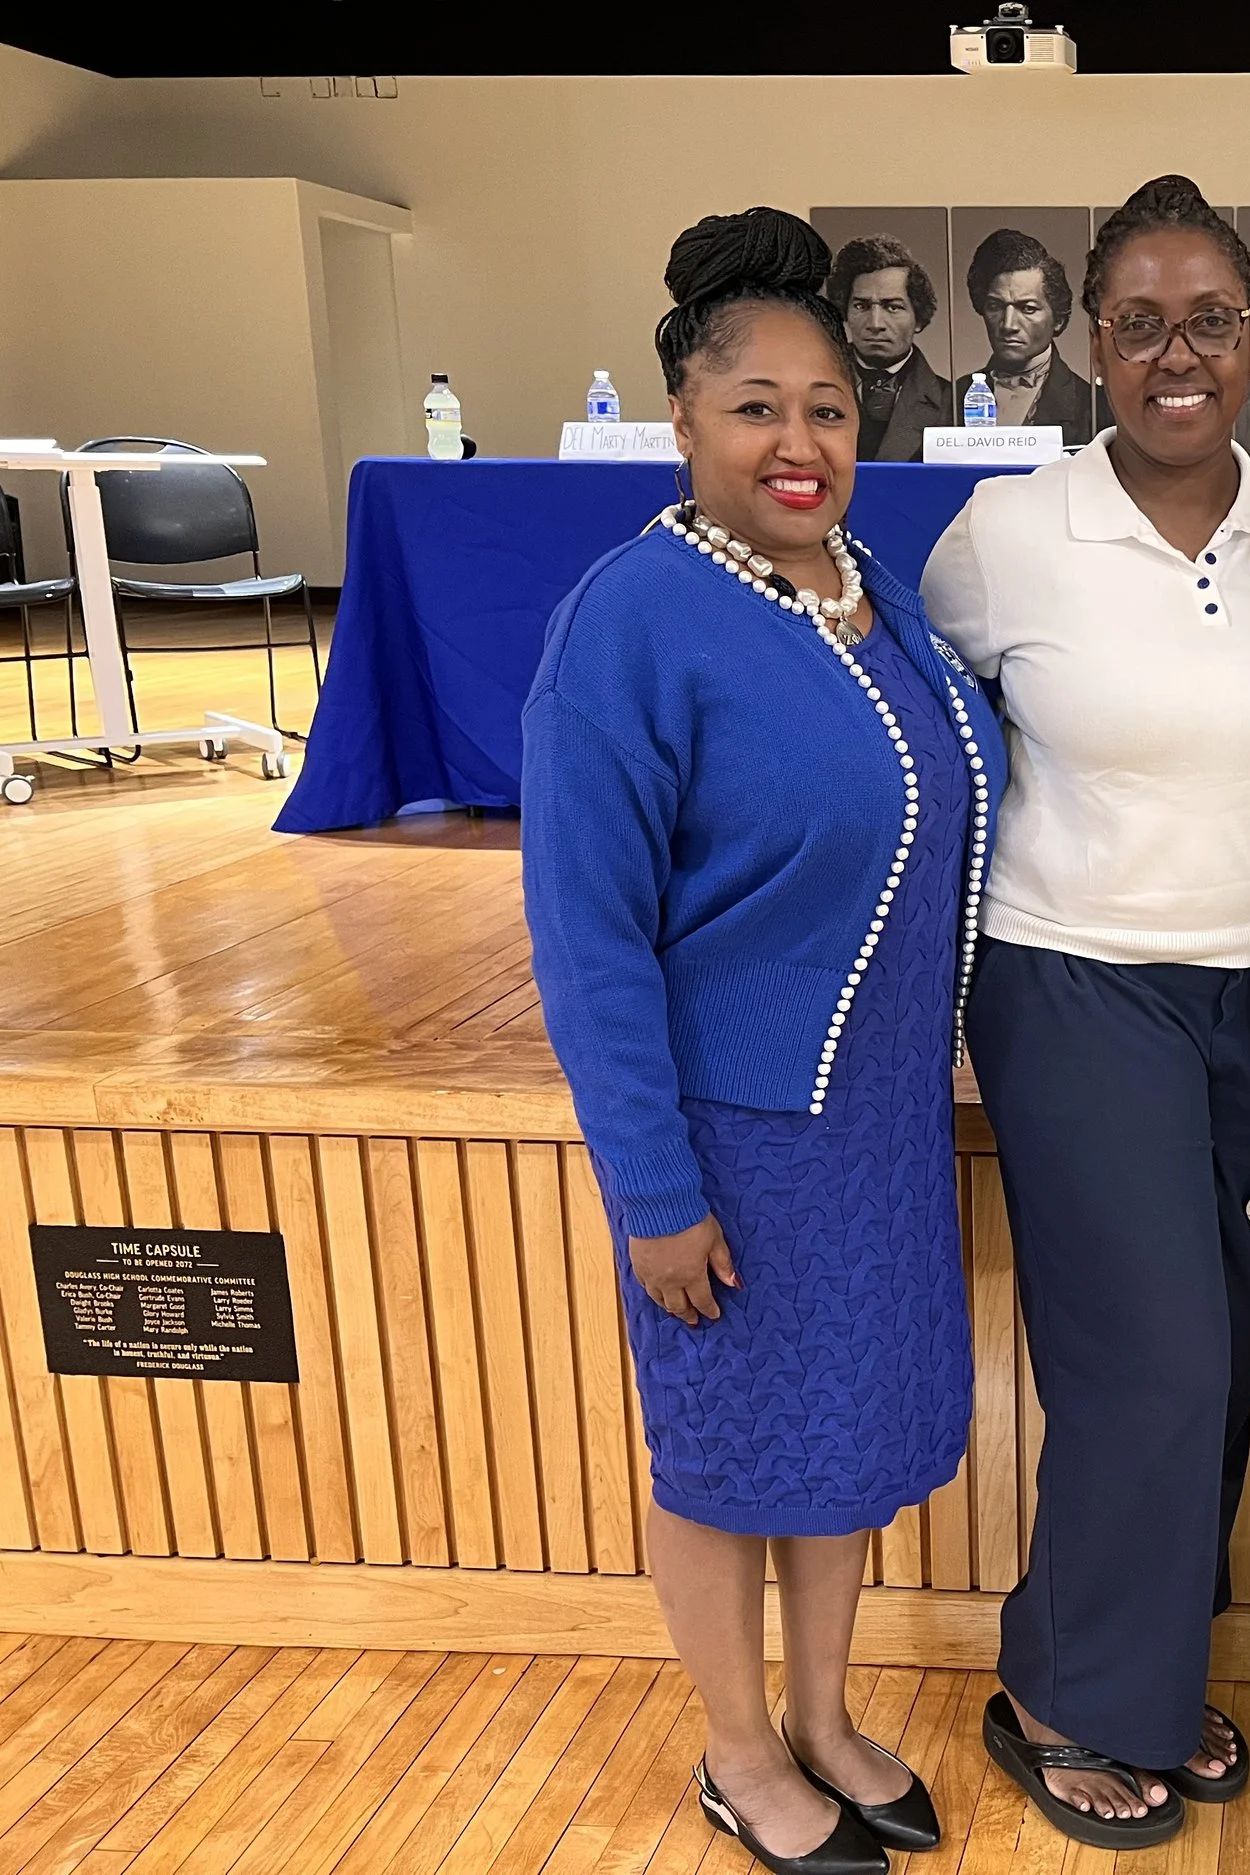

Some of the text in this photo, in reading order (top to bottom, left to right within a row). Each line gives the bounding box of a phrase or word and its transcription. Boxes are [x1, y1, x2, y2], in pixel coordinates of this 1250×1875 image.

[936, 436, 1037, 447] DEL. DAVID REID
[110, 1242, 202, 1258] TIME CAPSULE
[122, 1258, 193, 1269] TO BE OPENED 2072
[64, 1270, 256, 1286] DOUGLASS HIGH SCHOOL COMMEMORATIVE COMMITTEE
